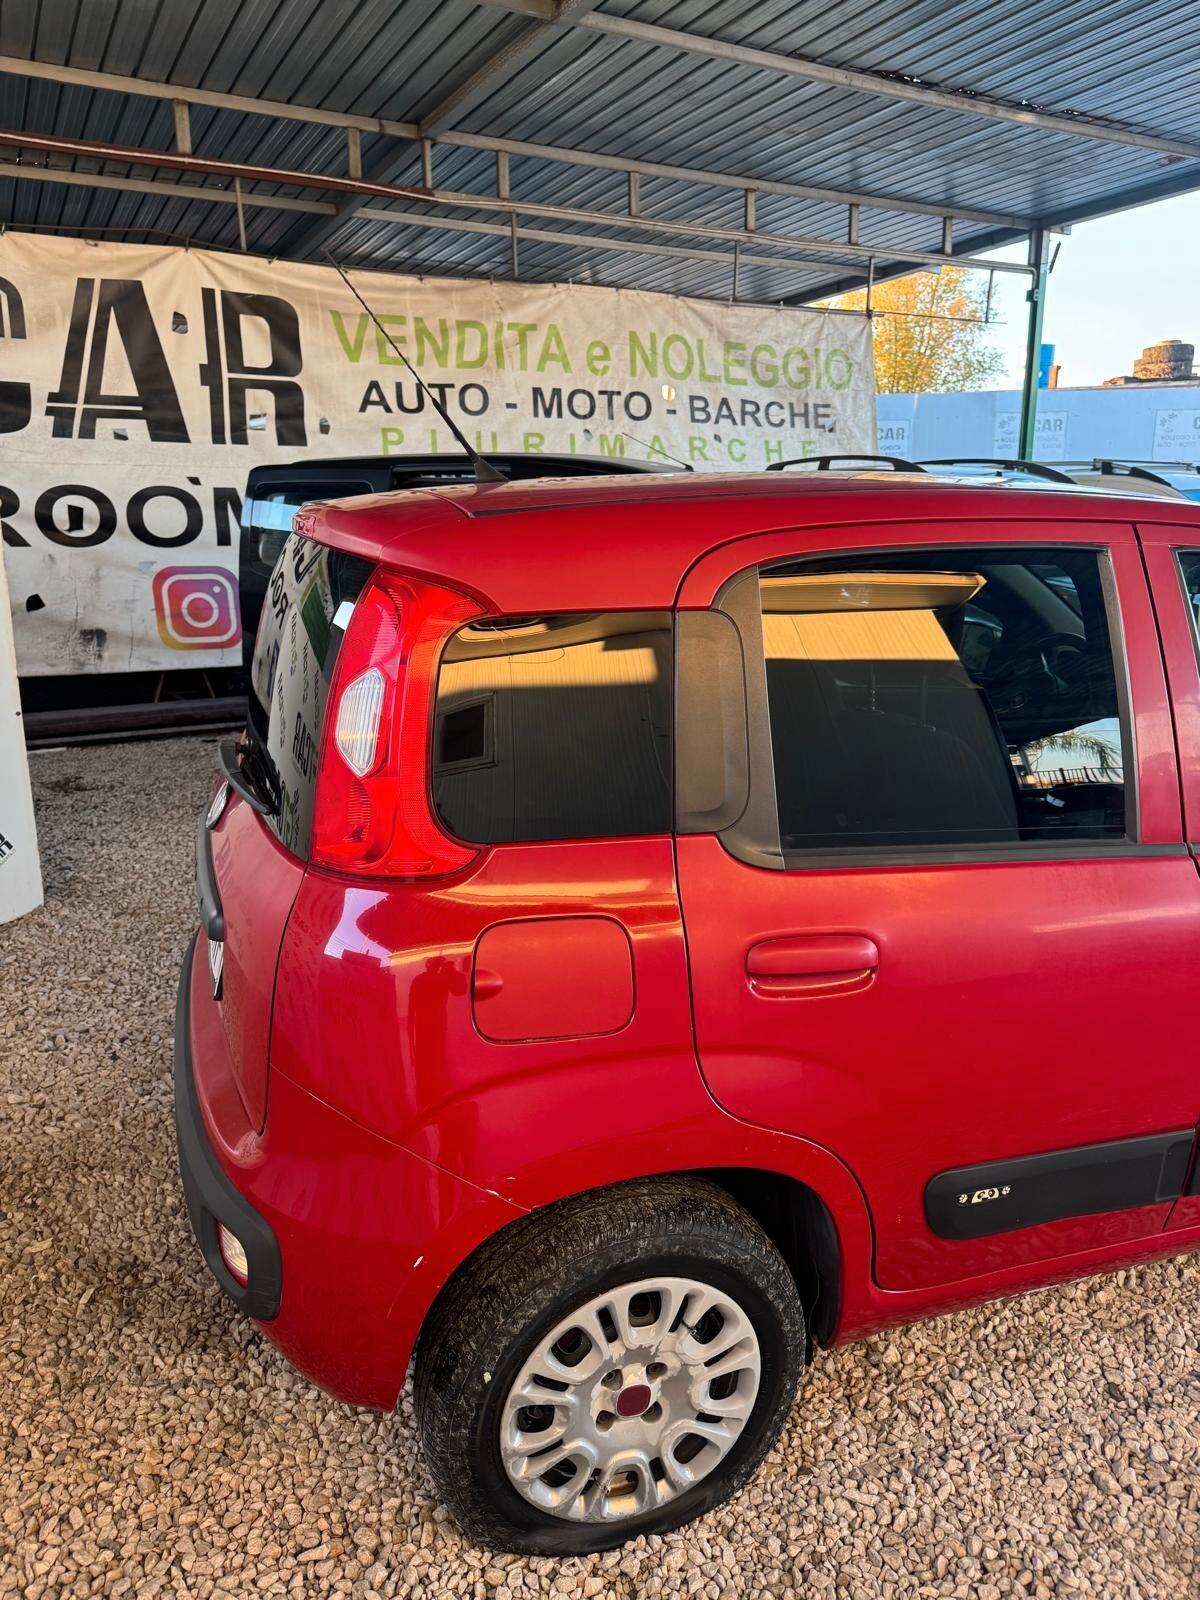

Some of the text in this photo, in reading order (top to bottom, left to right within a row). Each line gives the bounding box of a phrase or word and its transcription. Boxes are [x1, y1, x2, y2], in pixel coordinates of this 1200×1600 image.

[329, 309, 853, 391] VENDITA e NOLEGGIO
[358, 380, 490, 416] AUTO
[532, 386, 652, 421] MOTO
[688, 395, 832, 429] BARCHE
